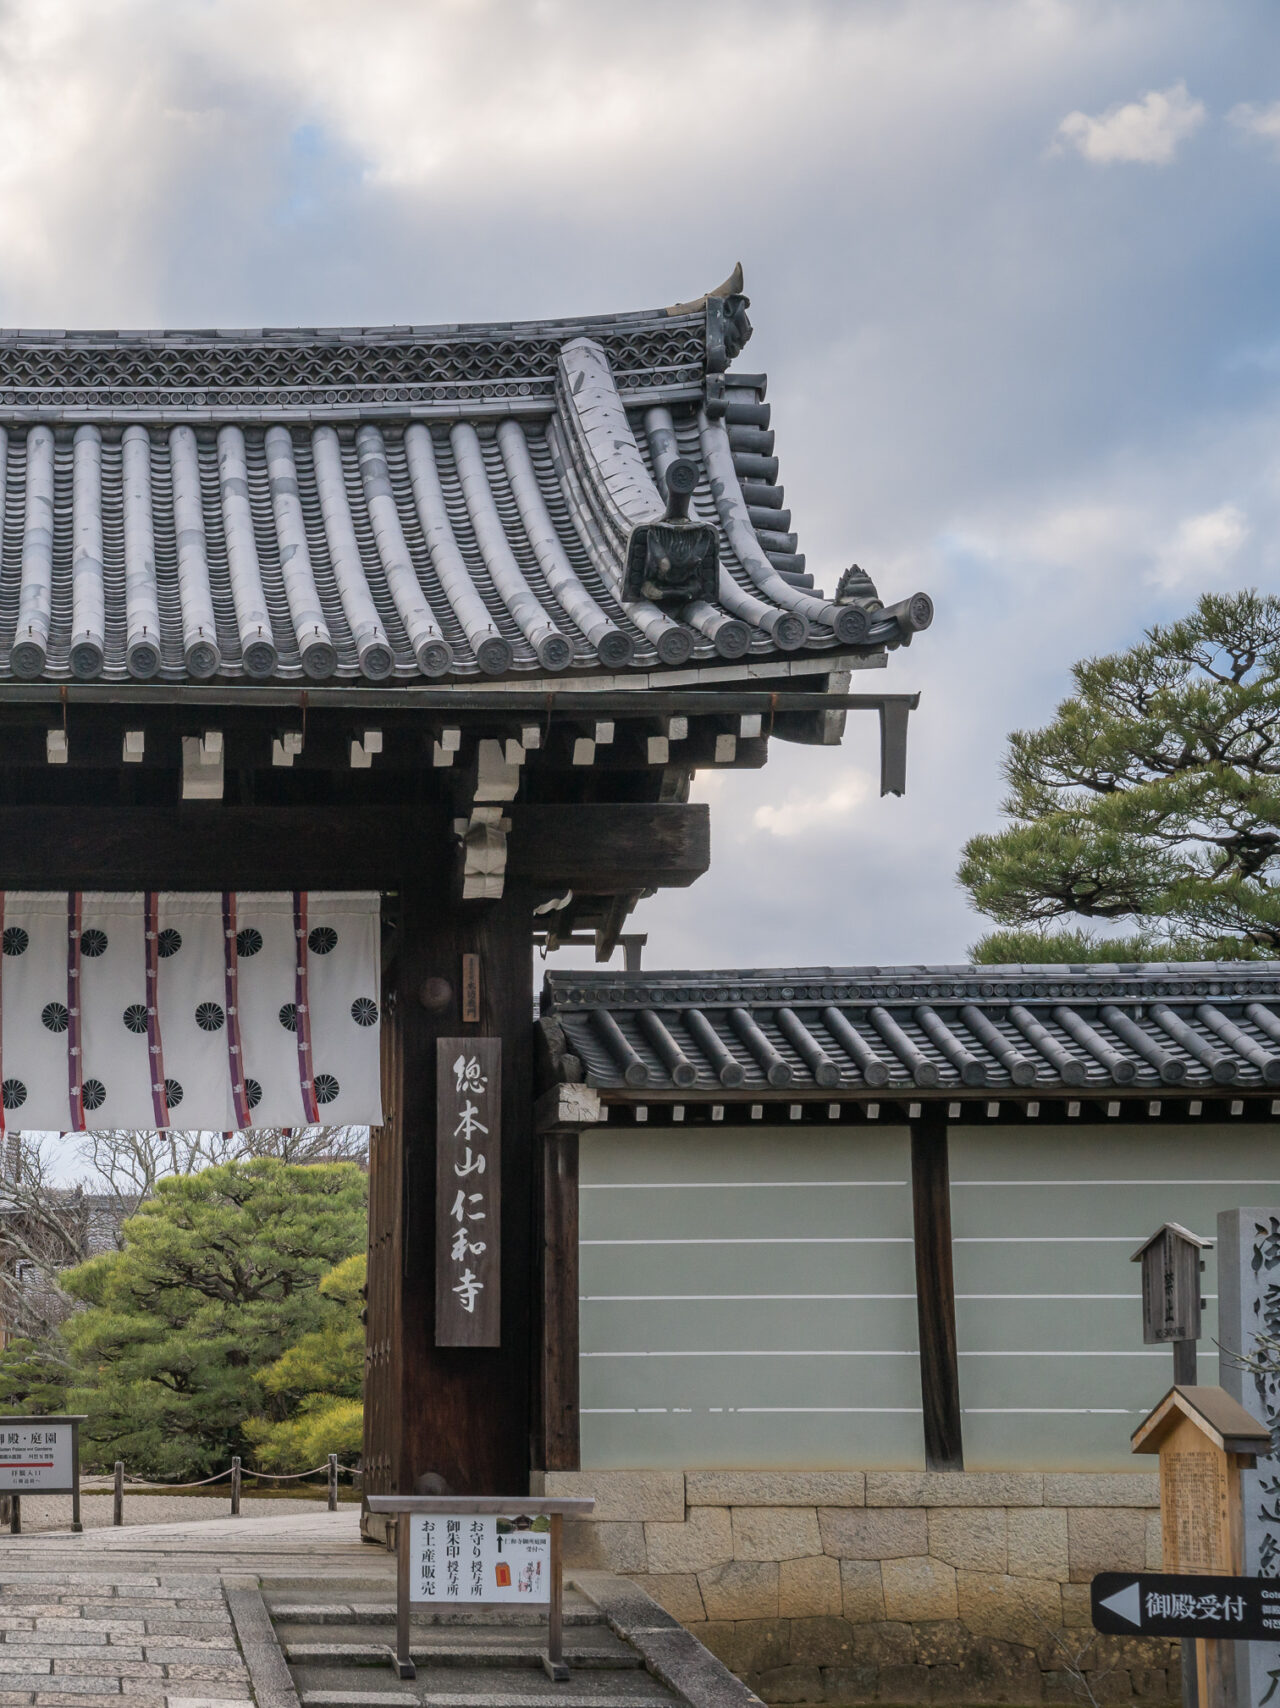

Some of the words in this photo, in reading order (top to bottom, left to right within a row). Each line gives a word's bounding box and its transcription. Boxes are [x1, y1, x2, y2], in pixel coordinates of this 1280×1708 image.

[421, 1520, 436, 1596] お土産販売
[1145, 1592, 1247, 1622] 御殿受付
